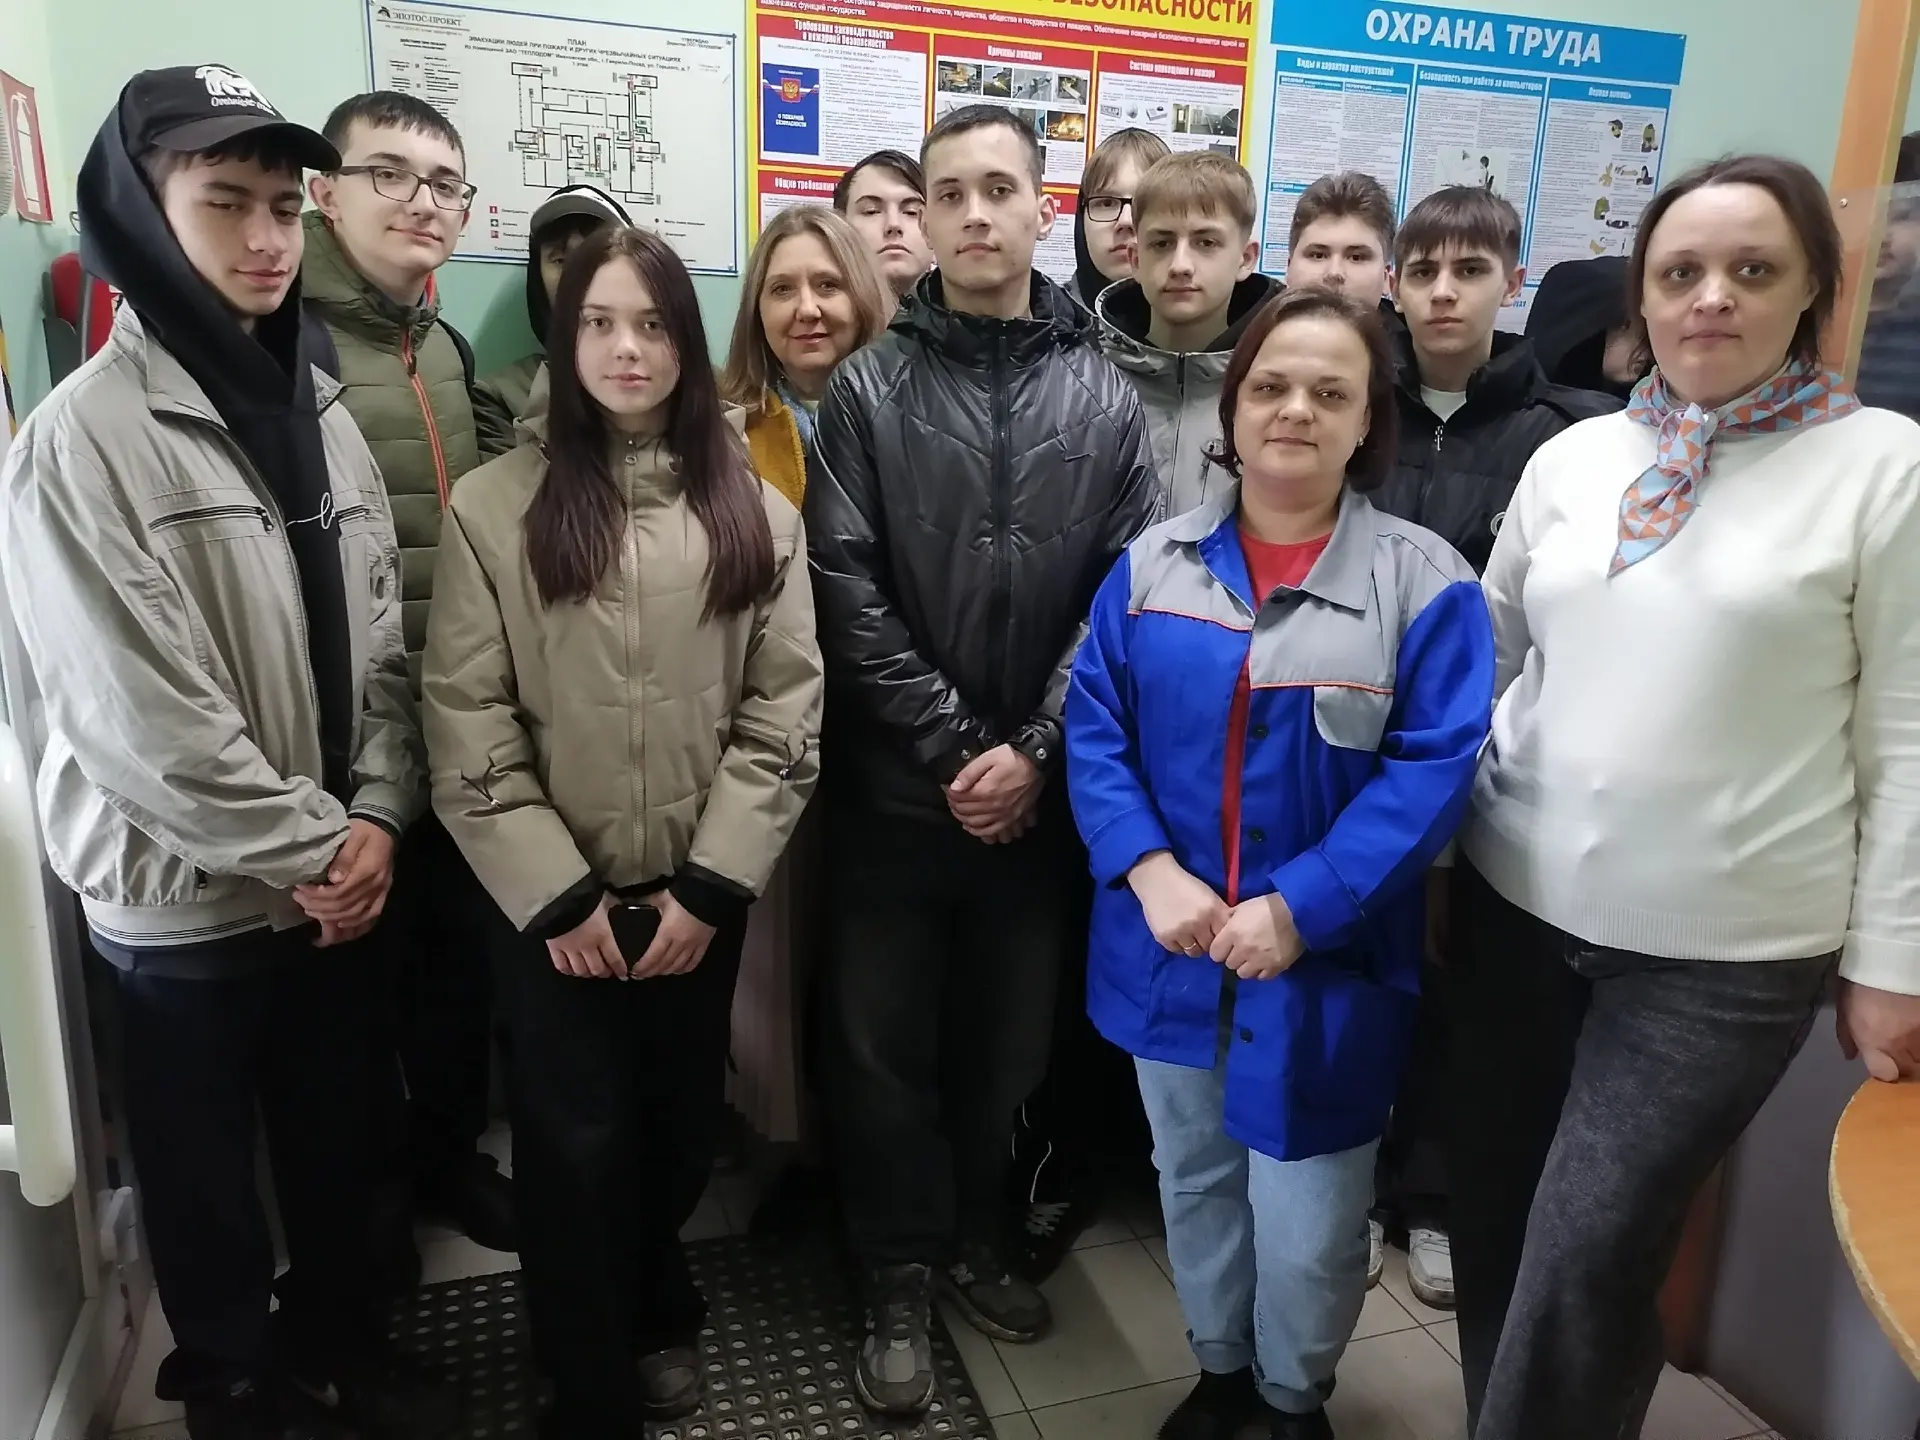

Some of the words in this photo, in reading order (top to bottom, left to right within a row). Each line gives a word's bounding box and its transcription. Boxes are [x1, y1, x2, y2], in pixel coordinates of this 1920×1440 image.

[393, 12, 462, 26] ЭПОТОС-ПРОЕКТ
[1053, 0, 1251, 25] ПАСНОСТИ
[795, 19, 834, 34] Требования
[834, 25, 894, 40] законодательства
[1023, 18, 1058, 28] государства
[1158, 31, 1195, 43] безопасности
[1366, 8, 1495, 52] ОХРАНА
[1506, 24, 1601, 67] ТРУДА
[567, 38, 587, 46] ПЛАН
[807, 32, 842, 45] пожарной
[841, 34, 887, 49] безопасности
[469, 36, 505, 45] ЭВАКУАЦИИ
[598, 50, 647, 59] ЧРЕЗВЫЧАЙНЫХ
[648, 54, 681, 62] СИТУАЦИЯХ
[518, 50, 554, 58] "ТЕПЛОДОМ"
[1129, 60, 1154, 72] Система
[1297, 57, 1315, 69] Виды
[1321, 62, 1350, 73] характер
[1420, 70, 1461, 83] Безопасность
[1462, 75, 1473, 85] при
